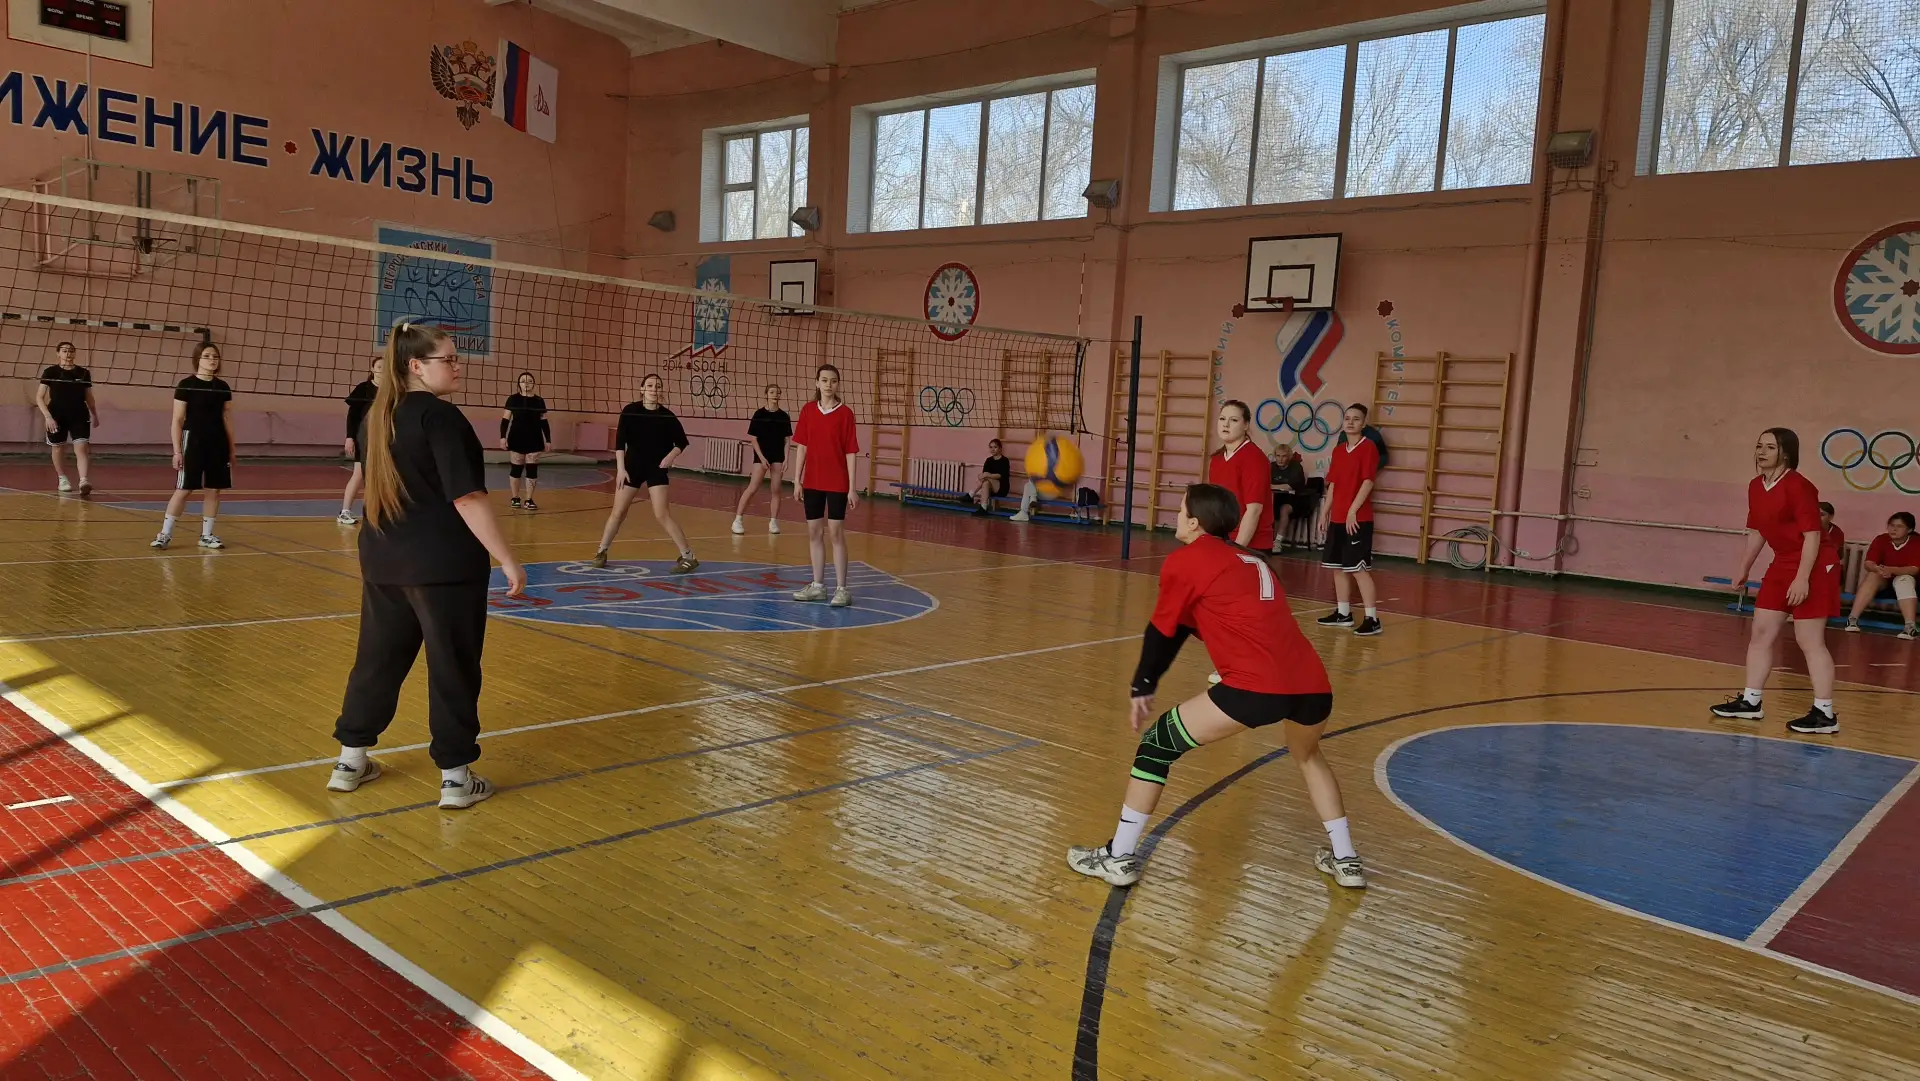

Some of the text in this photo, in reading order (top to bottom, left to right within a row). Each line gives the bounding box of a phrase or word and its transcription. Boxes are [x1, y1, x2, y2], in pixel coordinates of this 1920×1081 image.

[310, 127, 493, 205] ЖИЗНЬ
[662, 359, 729, 374] 2014 SOCHI
